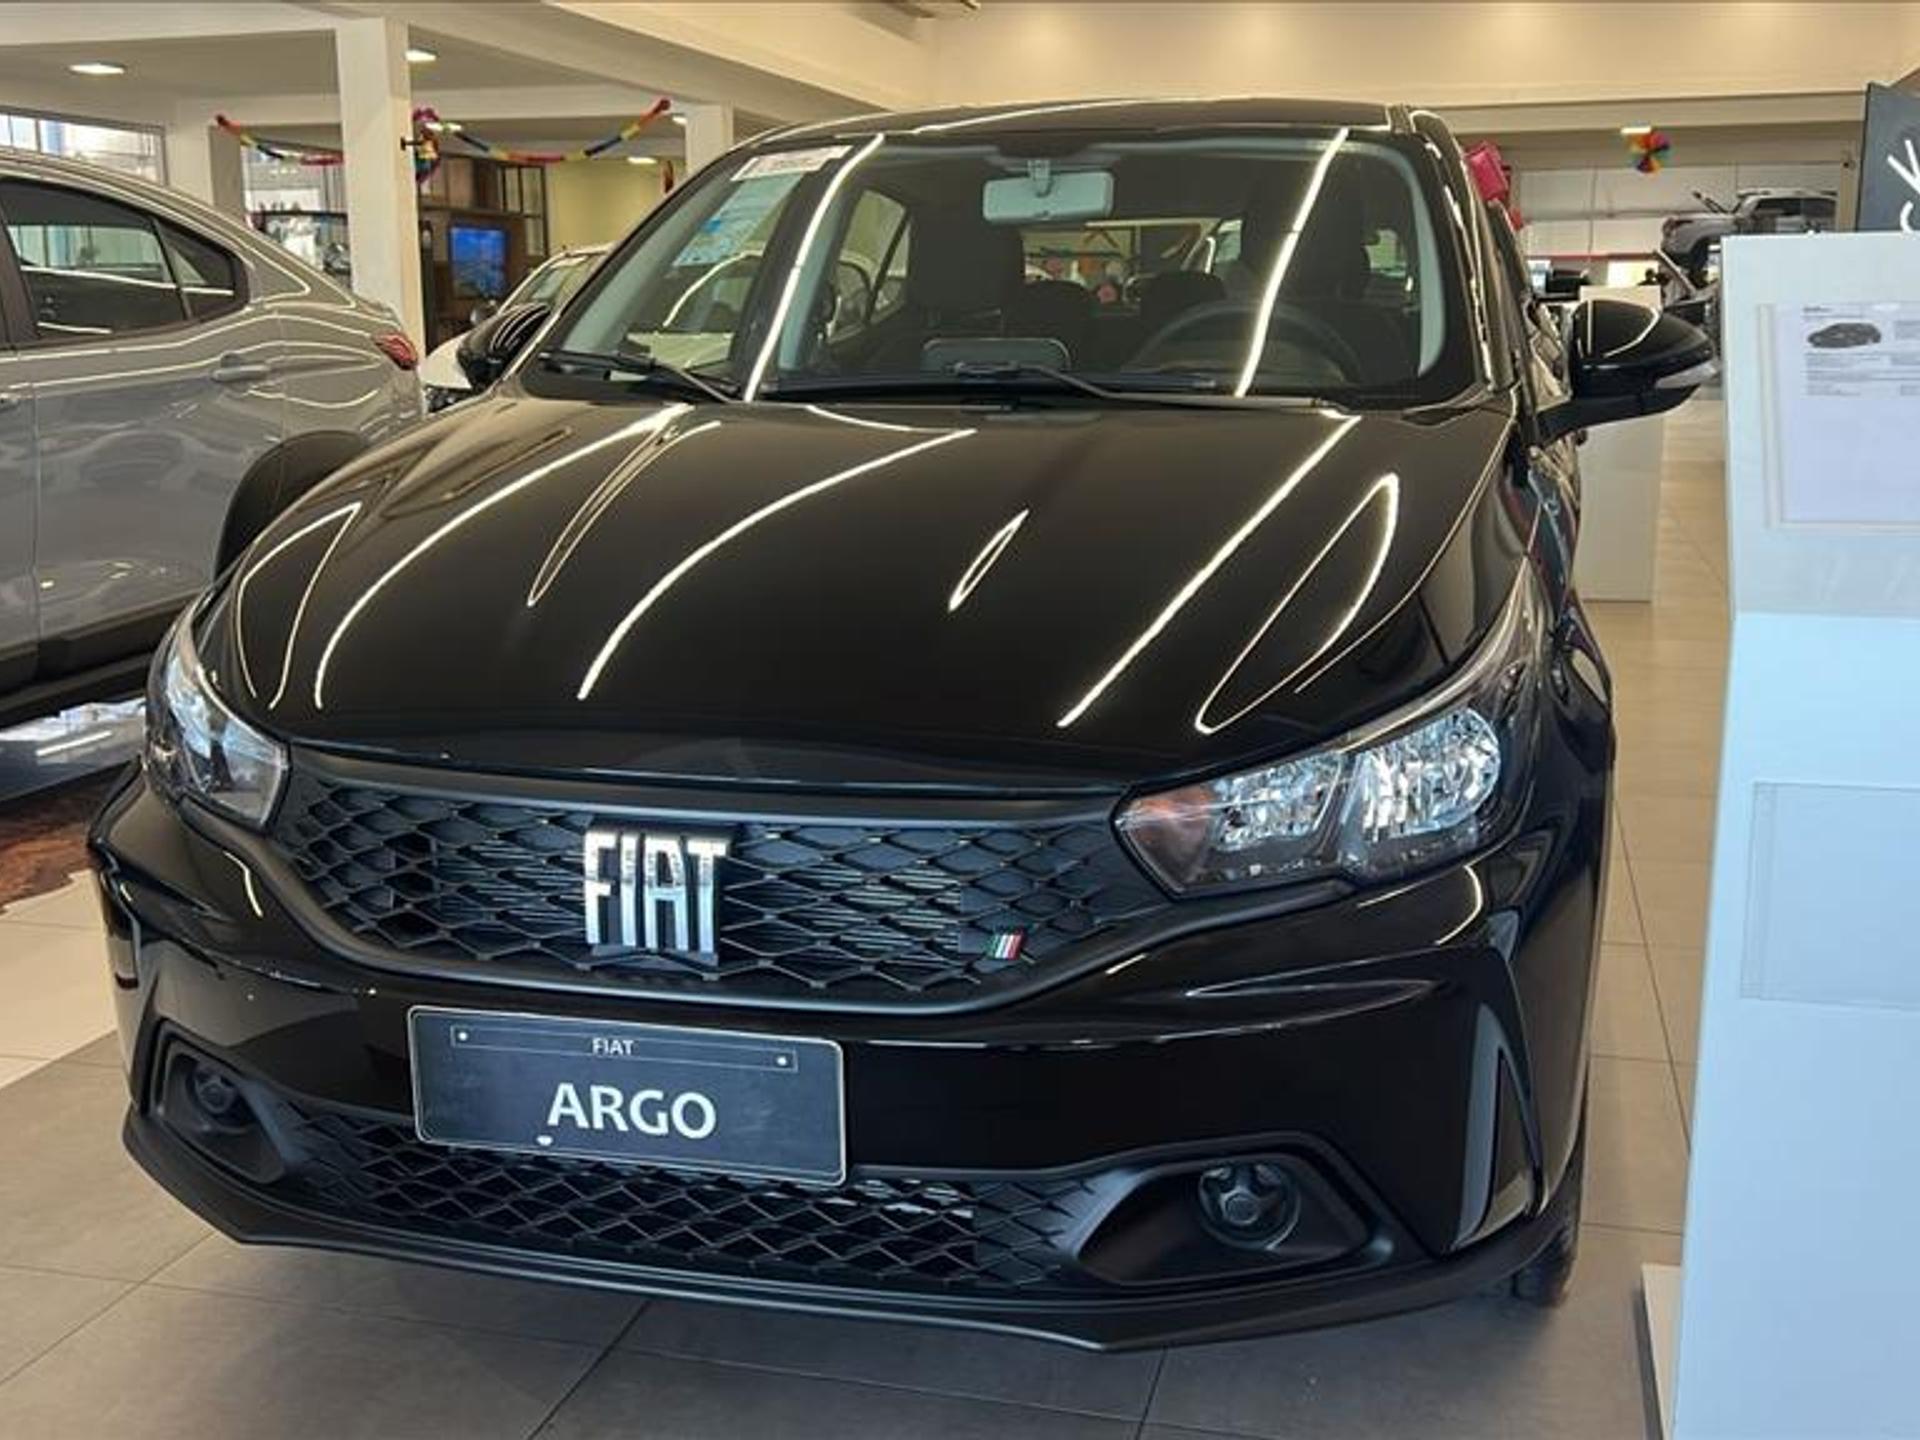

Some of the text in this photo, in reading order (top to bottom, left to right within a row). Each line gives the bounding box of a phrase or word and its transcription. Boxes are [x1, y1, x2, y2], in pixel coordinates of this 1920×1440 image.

[584, 831, 727, 953] FIAT
[592, 1037, 635, 1056] FIAT
[547, 1082, 717, 1139] ARGO
